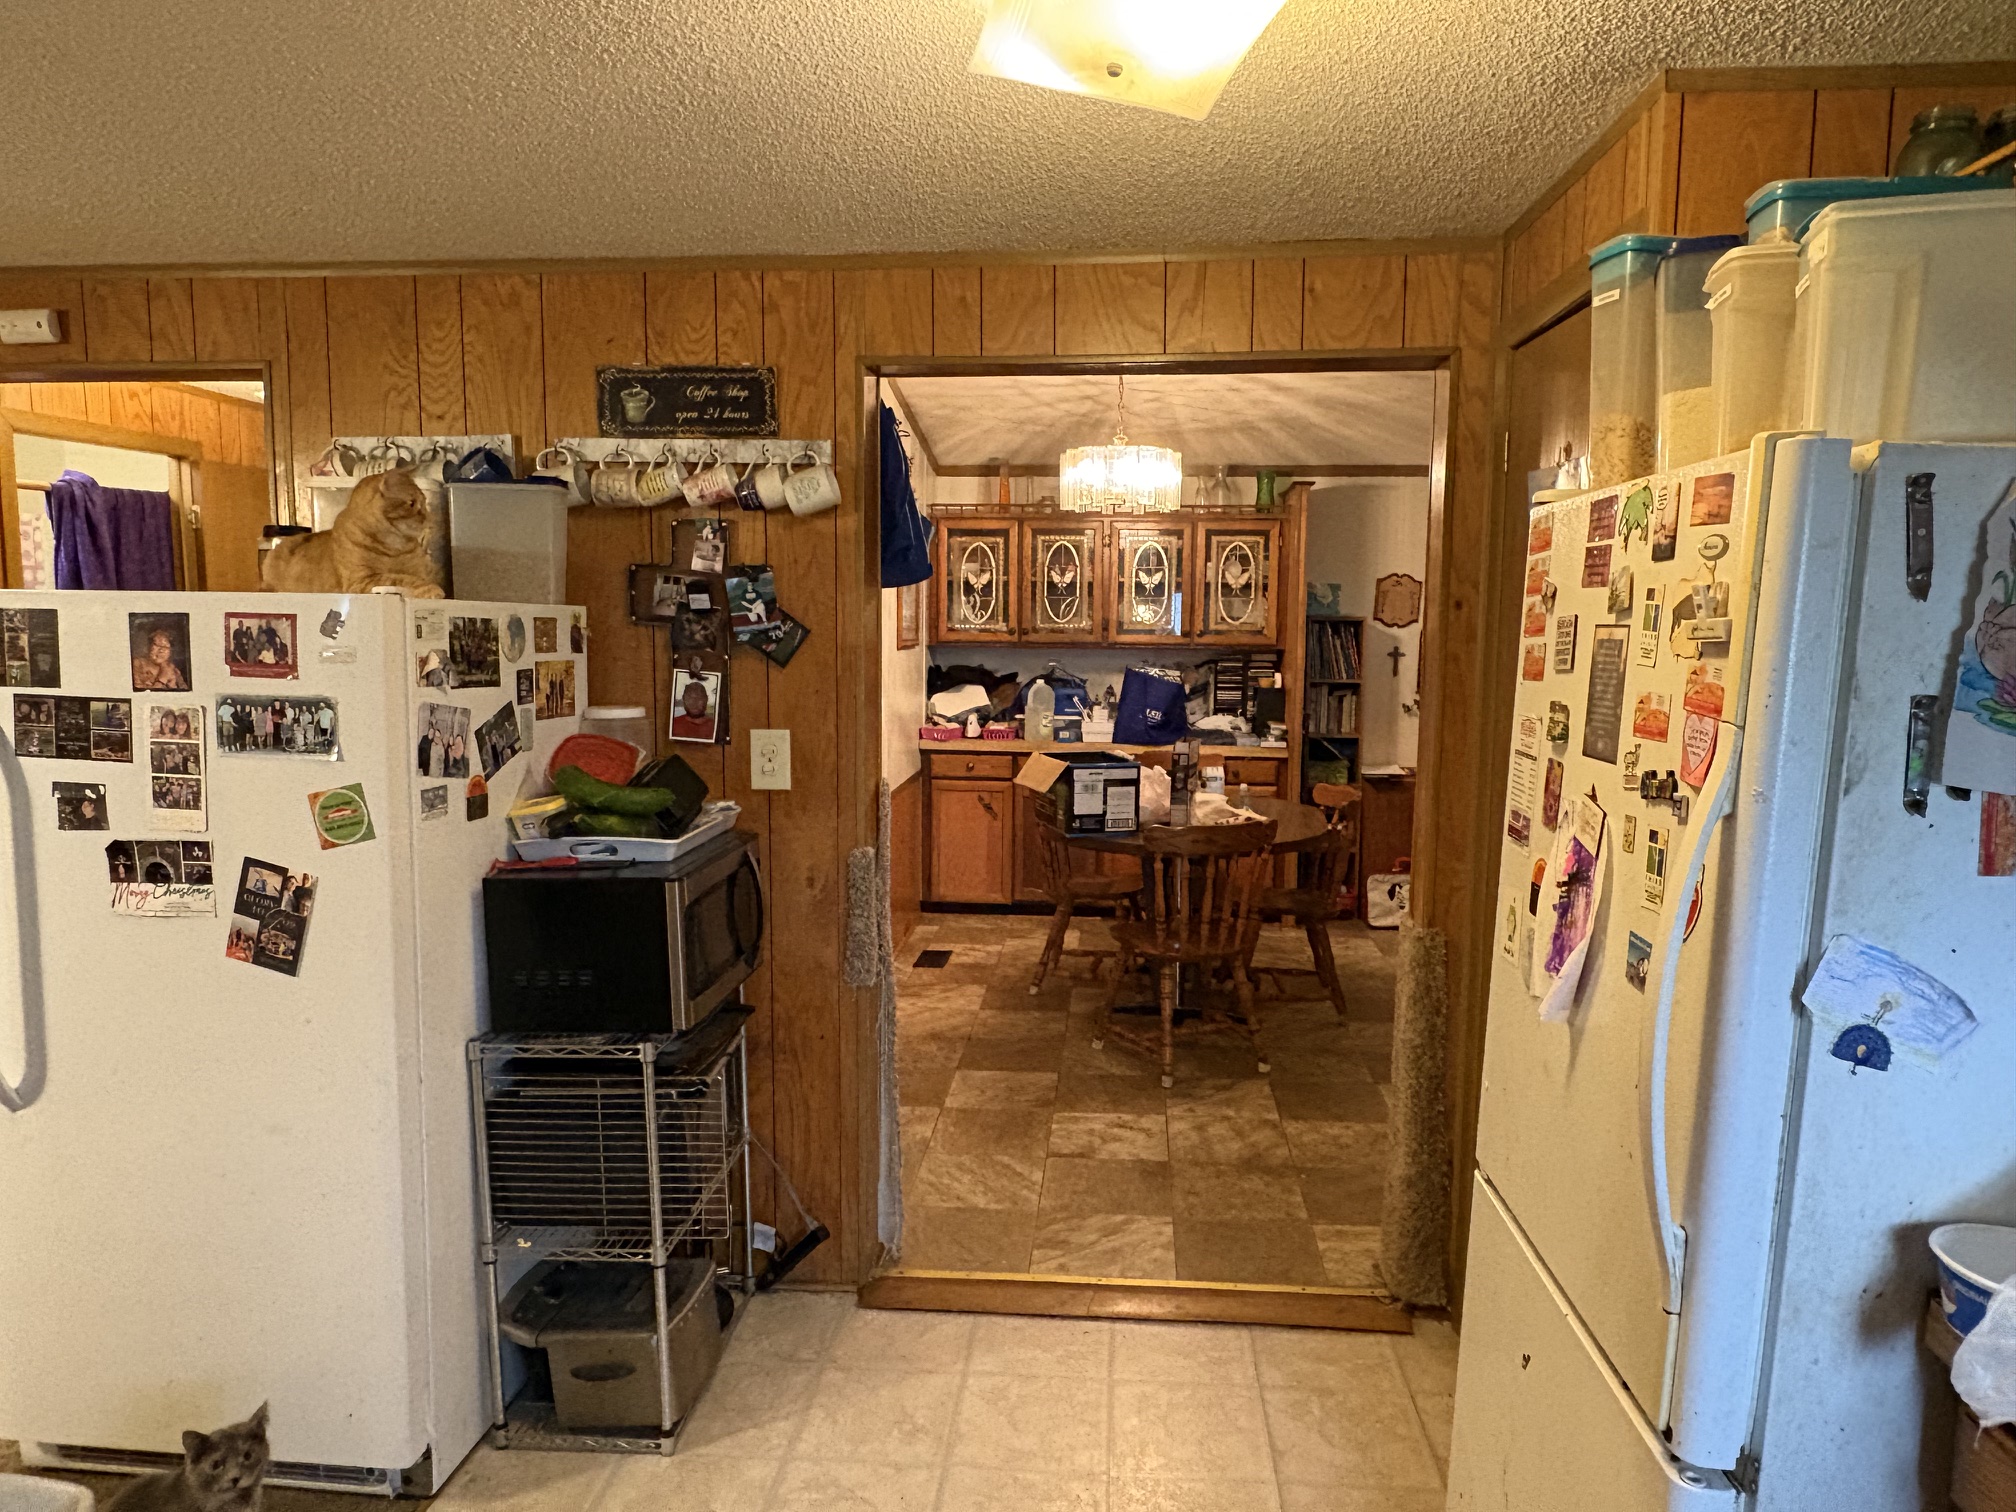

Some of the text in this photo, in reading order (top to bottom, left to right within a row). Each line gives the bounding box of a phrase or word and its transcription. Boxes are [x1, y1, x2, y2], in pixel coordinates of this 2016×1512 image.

[686, 385, 749, 402] Coffee Shop
[675, 411, 699, 424] open
[722, 407, 749, 419] hours
